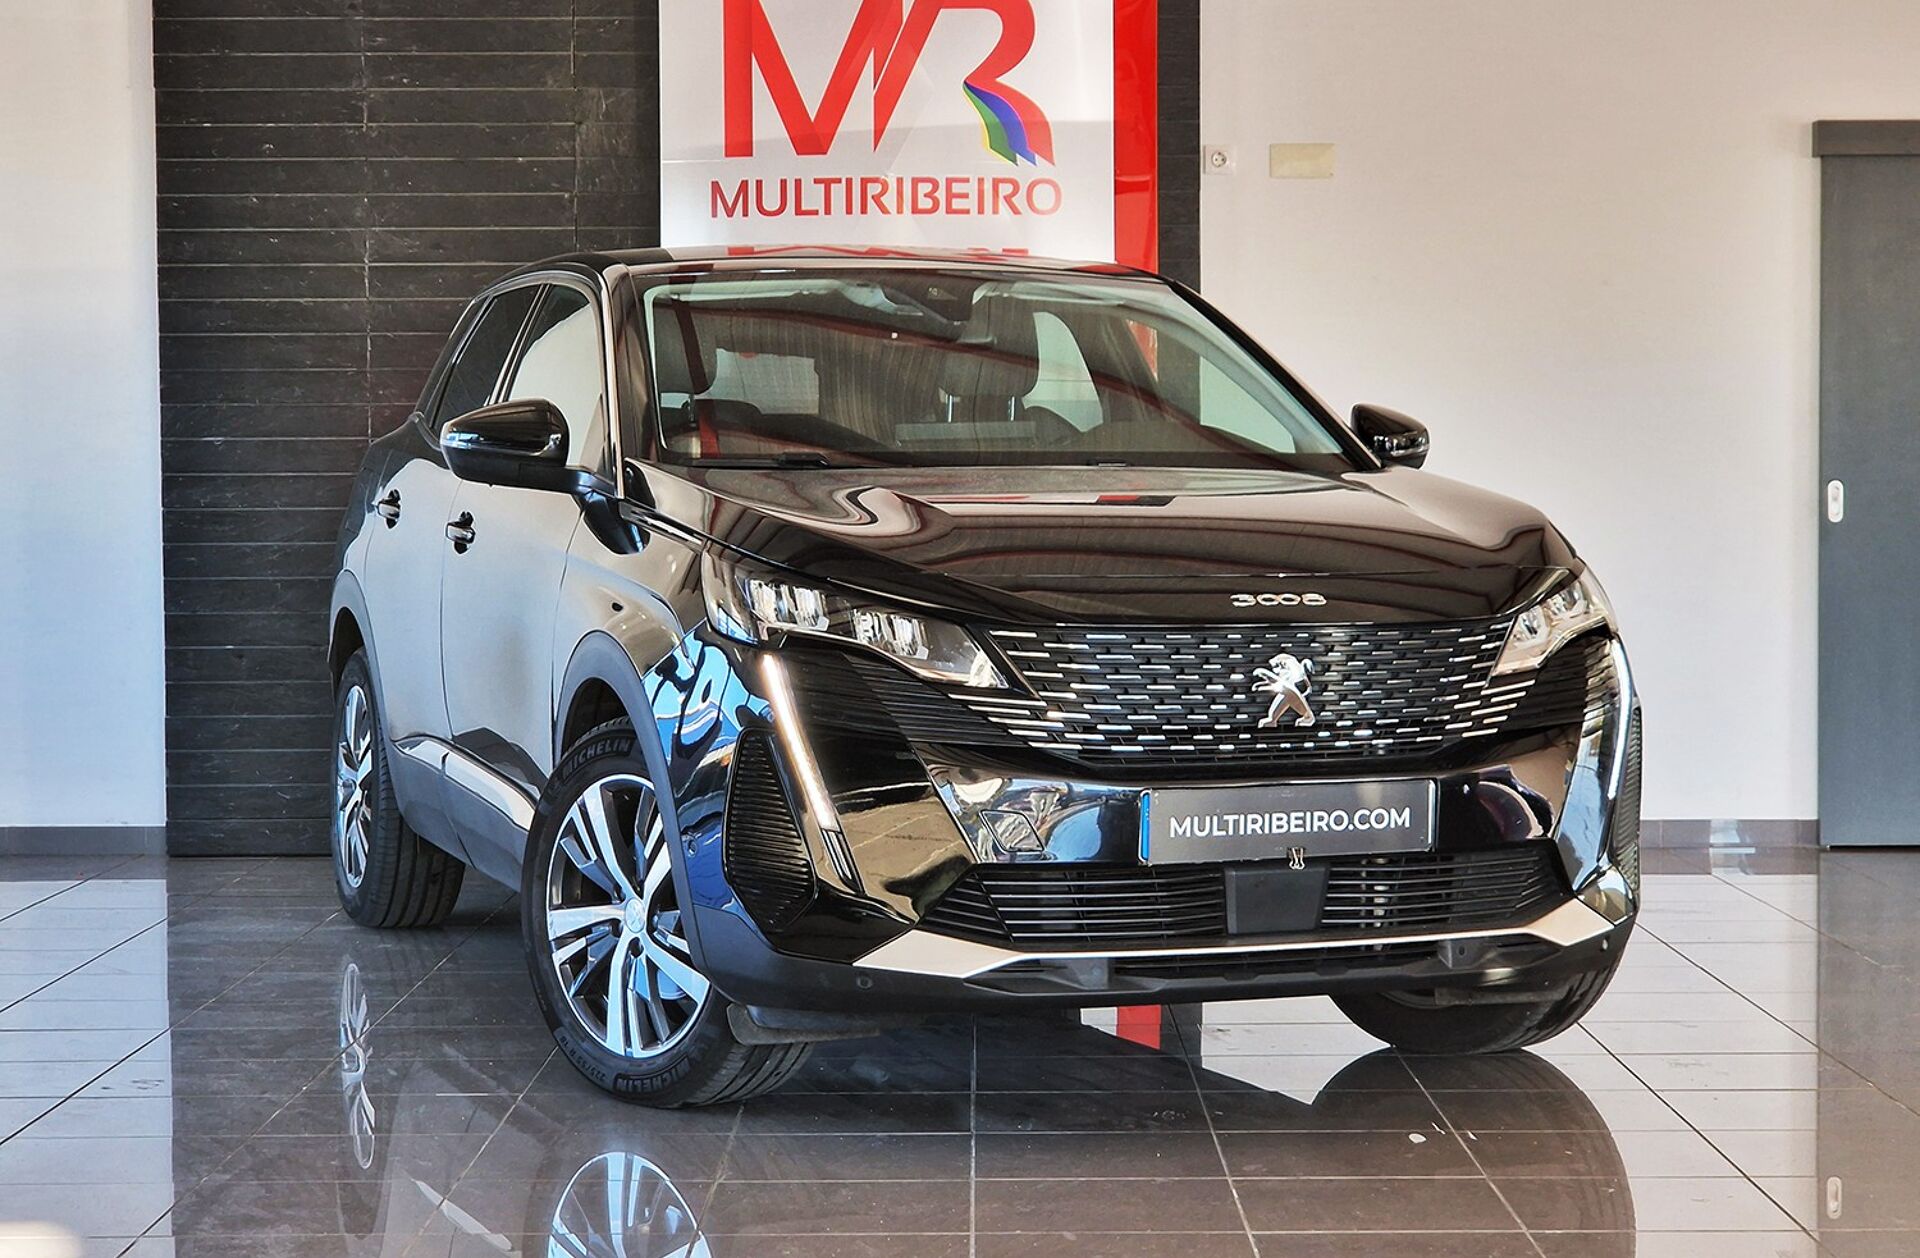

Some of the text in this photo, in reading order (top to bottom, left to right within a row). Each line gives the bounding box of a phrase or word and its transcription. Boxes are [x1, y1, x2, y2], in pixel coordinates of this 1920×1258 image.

[710, 177, 1062, 218] MULTIRIBEIRO
[1230, 593, 1327, 607] 3008
[1169, 807, 1410, 838] MULTIRIBEIRO.COM
